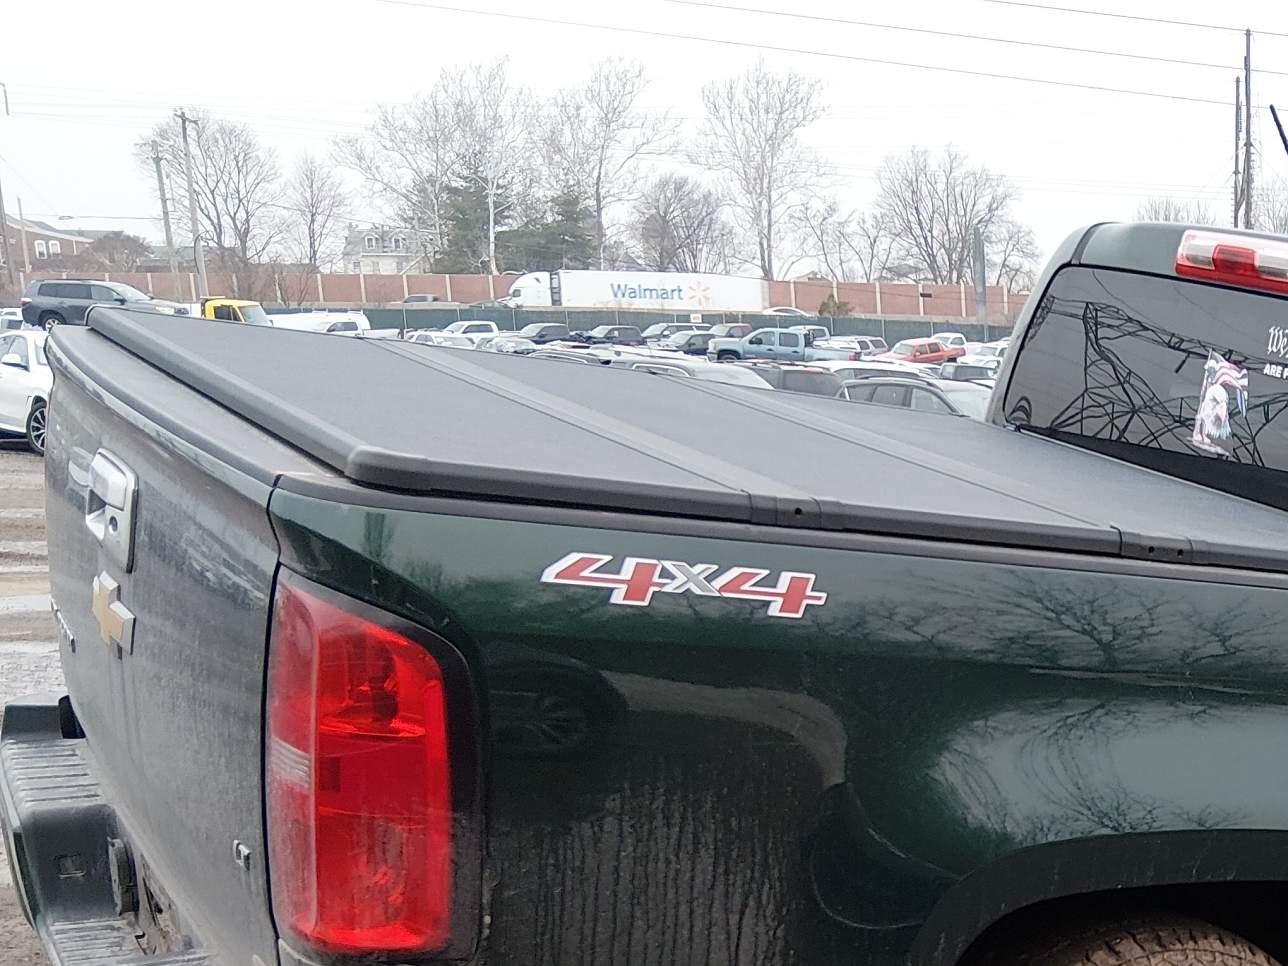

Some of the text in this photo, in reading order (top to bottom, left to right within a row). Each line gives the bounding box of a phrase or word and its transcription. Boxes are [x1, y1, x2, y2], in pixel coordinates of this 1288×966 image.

[610, 283, 684, 300] Walmart
[1267, 326, 1288, 357] We
[1264, 363, 1283, 378] ARE
